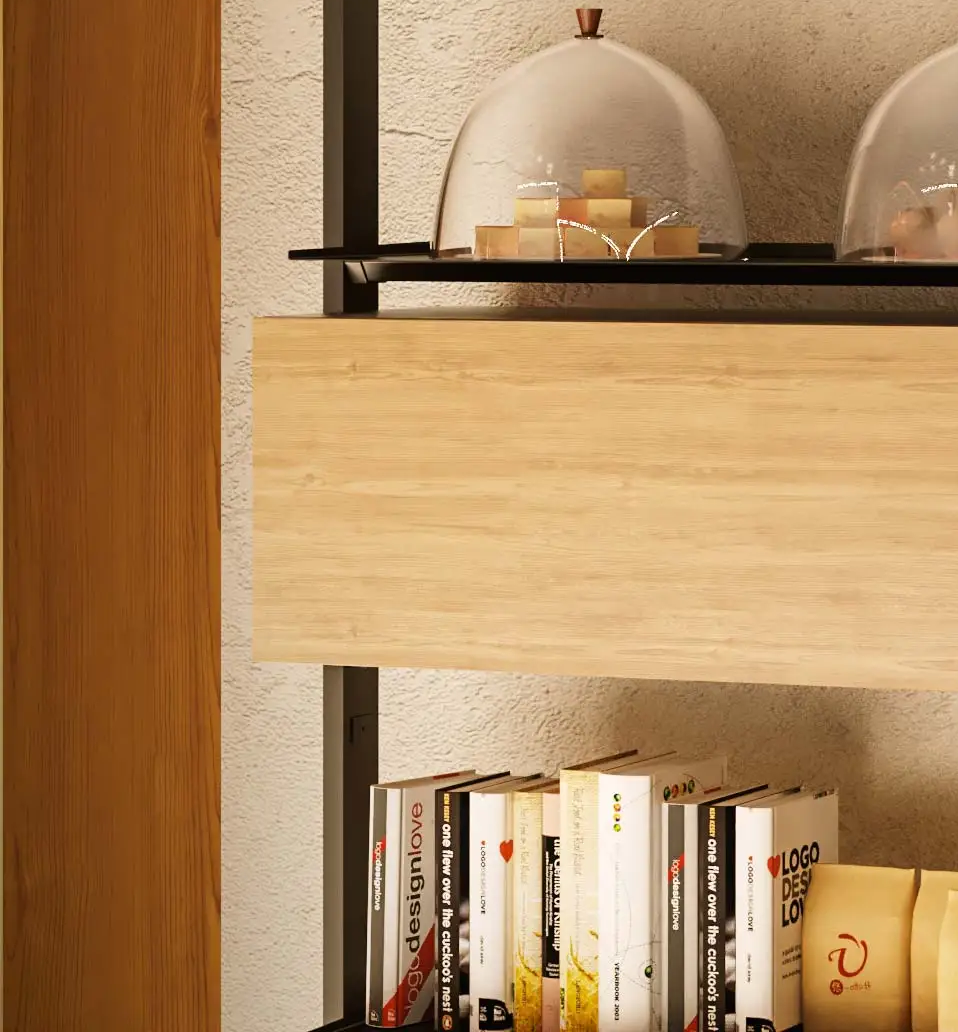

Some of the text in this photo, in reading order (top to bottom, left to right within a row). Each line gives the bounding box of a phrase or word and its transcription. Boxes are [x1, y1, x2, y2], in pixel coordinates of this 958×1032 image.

[373, 841, 383, 911] logodesignlove
[405, 802, 424, 1011] logodesignlove
[442, 824, 453, 1012] one flew over the cuckoo's nest
[671, 860, 681, 930] logodesignlove
[782, 841, 820, 876] LOGO
[707, 839, 719, 1031] one flew over the cuckoo's nest
